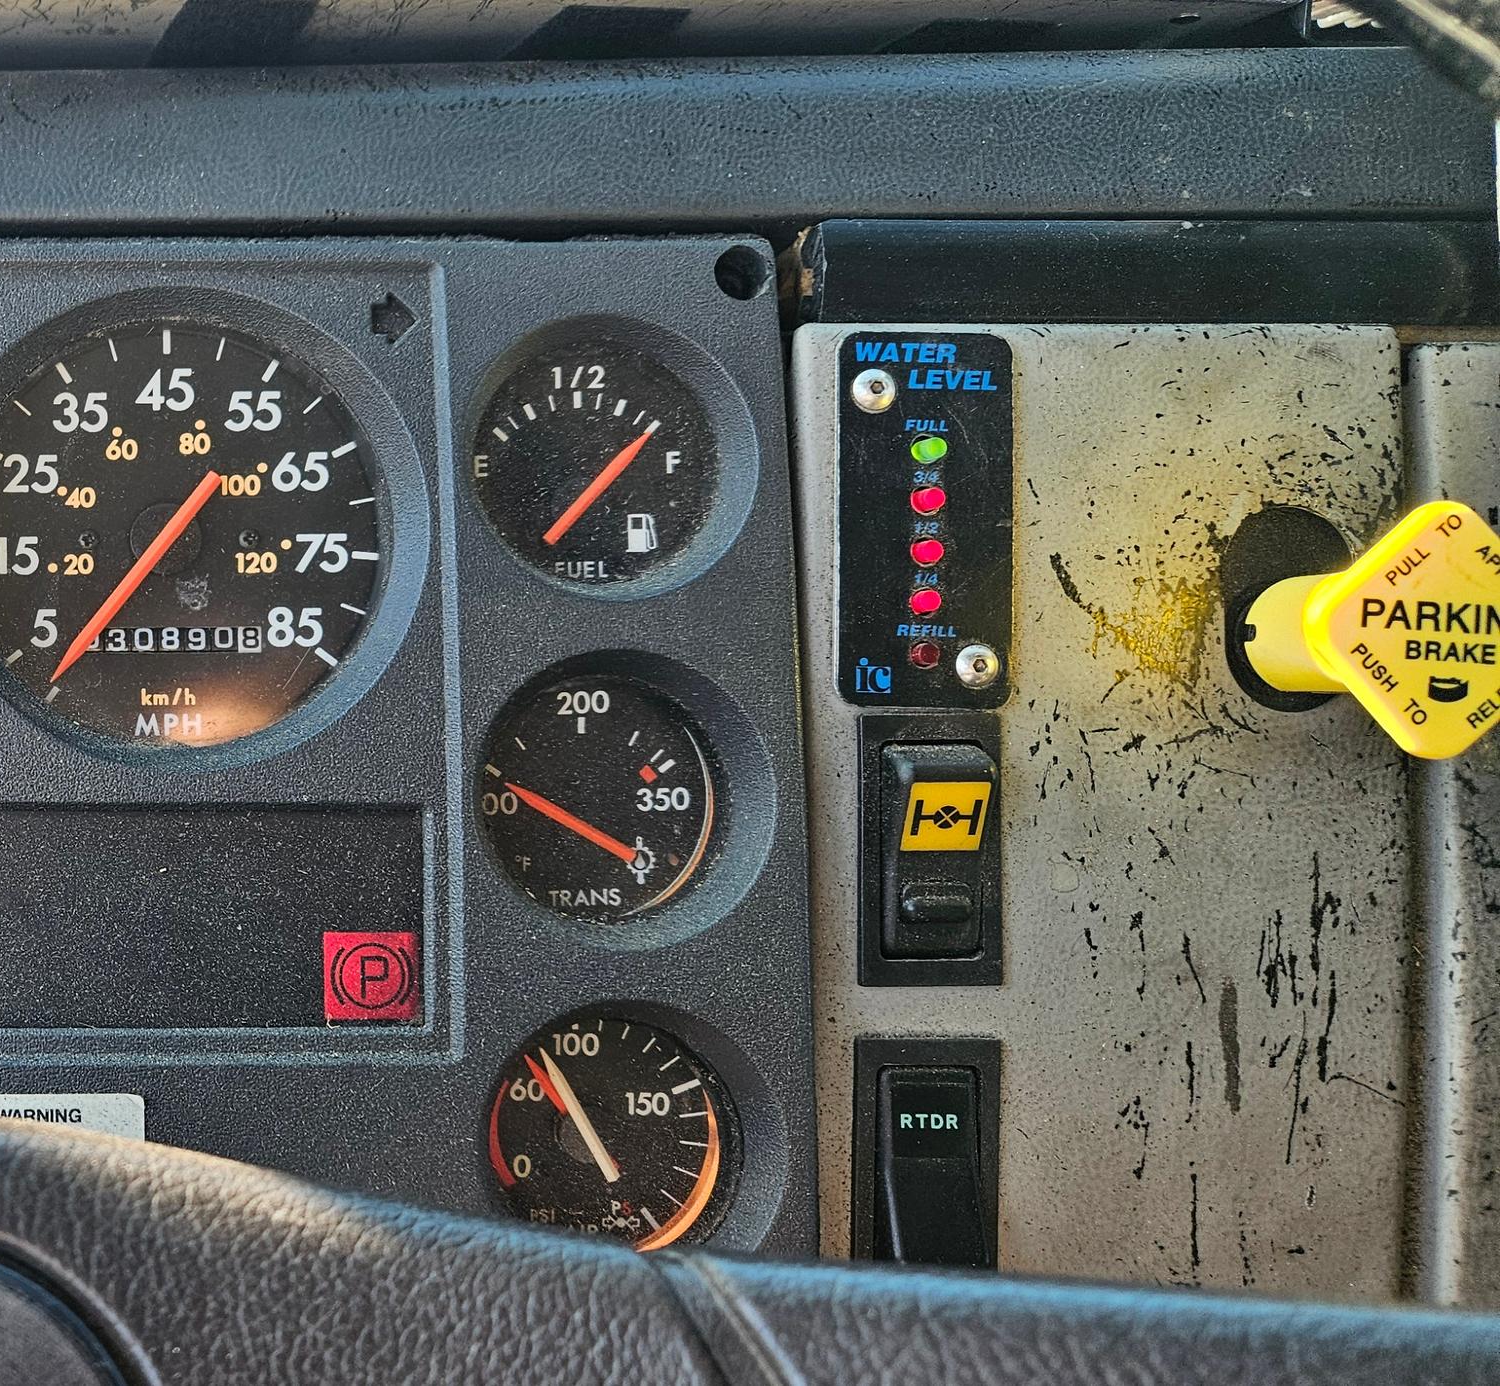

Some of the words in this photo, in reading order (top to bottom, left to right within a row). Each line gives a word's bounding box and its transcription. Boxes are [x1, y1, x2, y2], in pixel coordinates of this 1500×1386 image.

[855, 342, 957, 363] WATER
[551, 366, 605, 389] 1/2
[907, 370, 998, 391] LEVEL
[135, 368, 195, 411] 45
[52, 393, 108, 433] 35
[224, 391, 282, 432] 55
[905, 419, 949, 432] FULL
[105, 438, 138, 461] 60
[179, 432, 211, 455] 80
[3, 454, 59, 493] 25
[272, 452, 329, 491] 65
[474, 455, 488, 478] E
[665, 451, 681, 474] F
[220, 474, 261, 497] 100
[914, 471, 940, 483] 3/4
[65, 487, 96, 509] 40
[295, 533, 348, 573] 75
[1384, 548, 1431, 586] PULL
[1435, 514, 1462, 538] TO
[63, 553, 94, 575] 20
[235, 552, 277, 574] 120
[554, 561, 609, 578] FUEL
[914, 572, 939, 585] 1/4
[30, 608, 58, 647] 5
[267, 607, 323, 647] 85
[896, 624, 957, 637] REFILL
[1405, 640, 1496, 665] BRAKE
[1350, 642, 1399, 693] PUSH
[1403, 698, 1428, 726] TO
[140, 688, 196, 706] km/h
[556, 690, 610, 715] 200
[134, 713, 202, 737] MPH
[636, 787, 690, 811] 350
[549, 888, 622, 907] TRANS
[552, 1033, 599, 1056] 100
[510, 1078, 544, 1101] 60
[625, 1092, 670, 1116] 150
[900, 1113, 959, 1129] RTDR
[513, 1154, 532, 1178] 0
